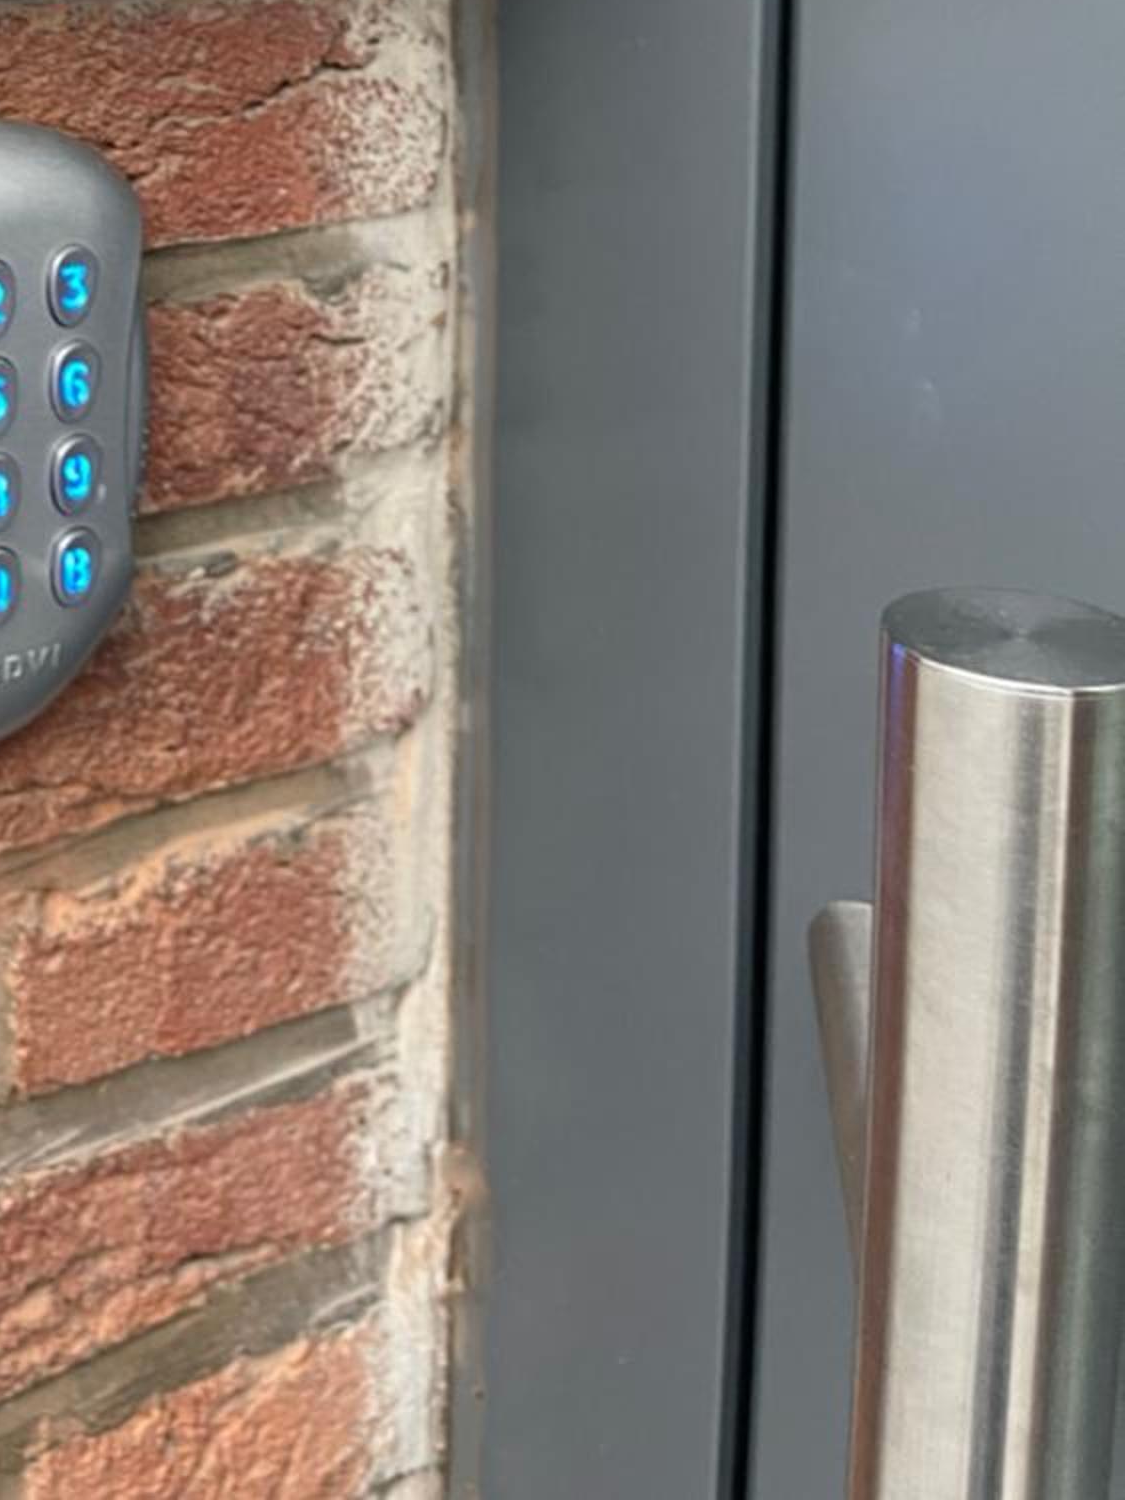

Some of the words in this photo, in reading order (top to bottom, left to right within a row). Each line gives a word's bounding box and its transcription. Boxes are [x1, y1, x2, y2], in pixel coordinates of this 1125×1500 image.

[60, 263, 89, 311] 3
[60, 360, 90, 407] 6
[62, 453, 92, 500] 9
[61, 547, 91, 595] B
